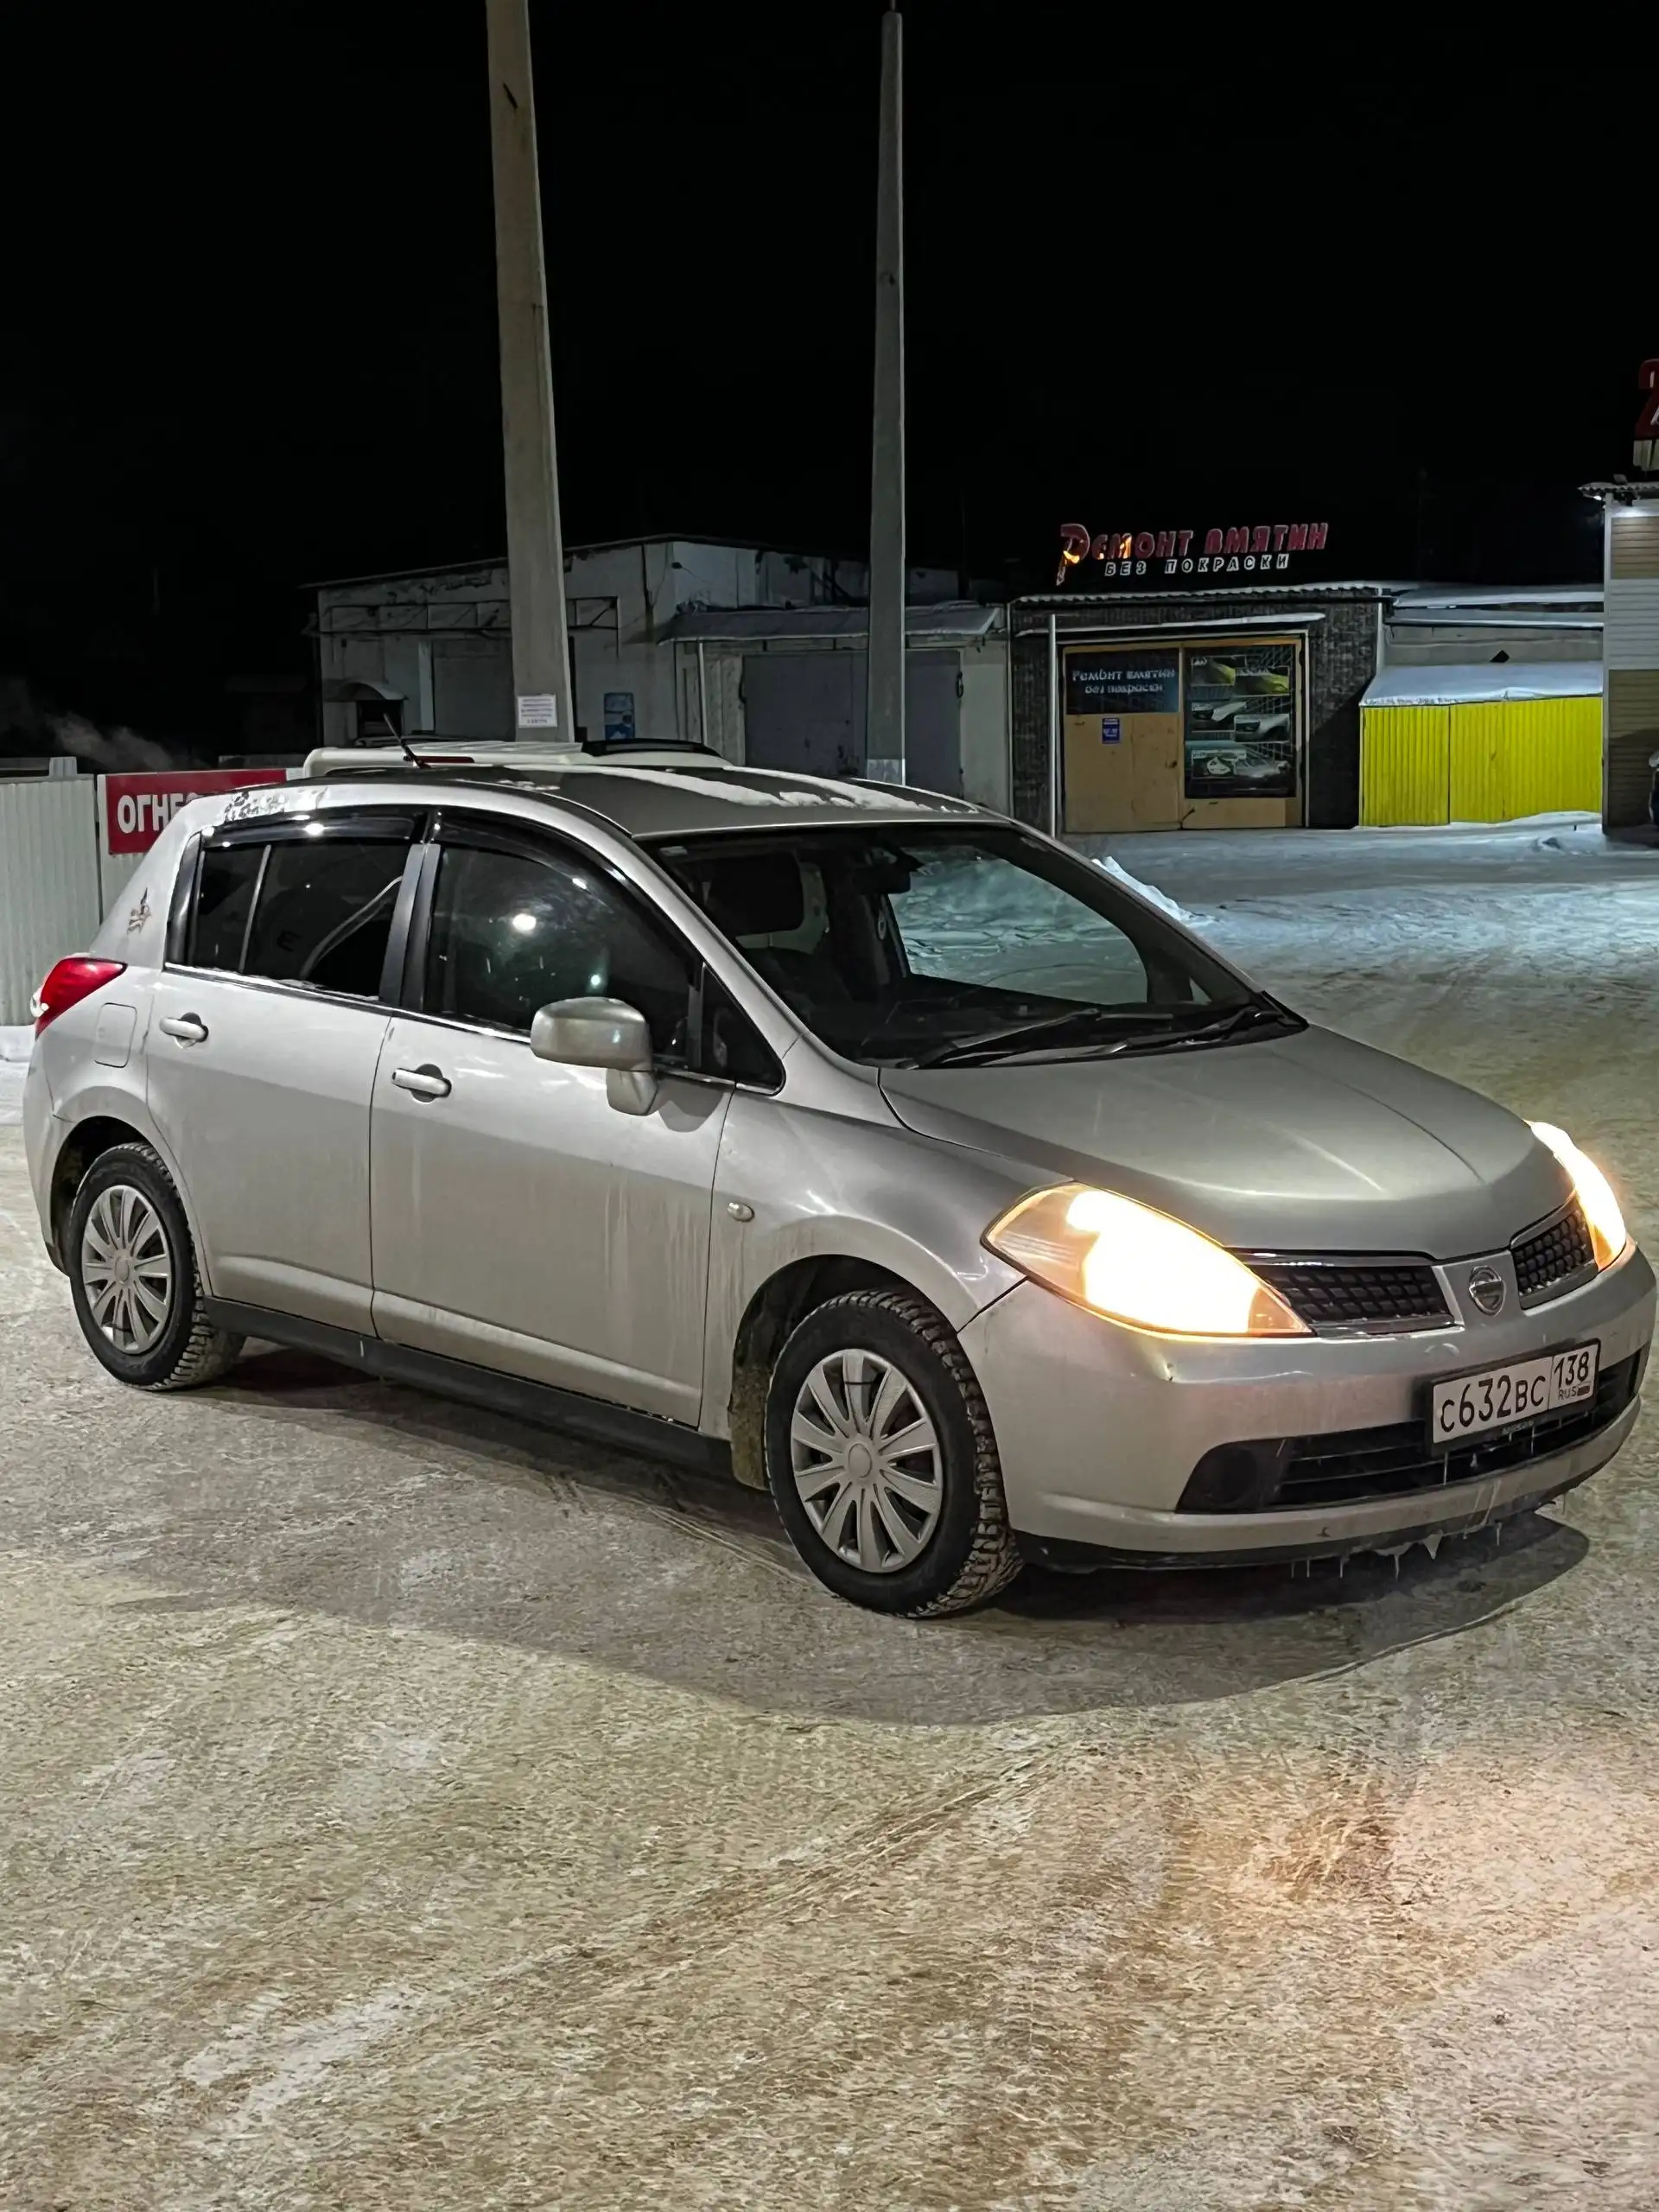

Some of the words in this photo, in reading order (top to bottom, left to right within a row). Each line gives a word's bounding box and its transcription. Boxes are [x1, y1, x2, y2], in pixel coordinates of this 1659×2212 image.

[1104, 561, 1147, 577] БЕЗ
[1164, 553, 1290, 575] ПОКРАСКИ
[1440, 1374, 1547, 1433] С632ВС
[1554, 1351, 1590, 1389] 138
[1558, 1386, 1578, 1401] RUS
